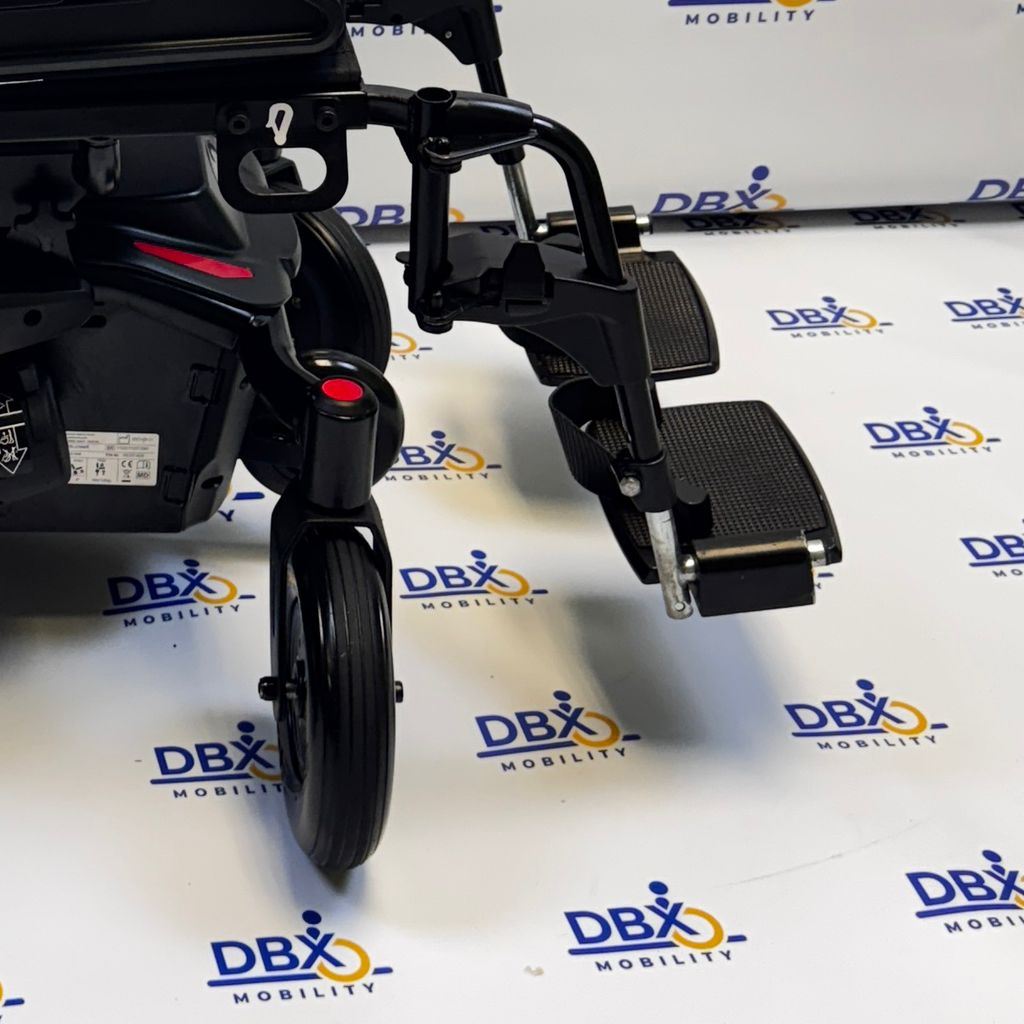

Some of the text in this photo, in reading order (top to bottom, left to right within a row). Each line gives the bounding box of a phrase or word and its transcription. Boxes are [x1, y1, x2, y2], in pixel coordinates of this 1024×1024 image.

[686, 10, 813, 24] MOBILITY
[651, 189, 771, 213] DBX
[766, 307, 859, 325] DBX
[864, 419, 964, 443] DBX
[400, 444, 465, 465] BX
[893, 447, 990, 457] MOBILITY
[385, 472, 489, 481] MOBILITY
[959, 535, 1024, 559] DB
[107, 572, 216, 606] DBX
[400, 566, 509, 591] DBX
[422, 598, 534, 609] MOBILITY
[123, 604, 240, 627] MOBILITY
[784, 697, 904, 730] DBX
[476, 707, 598, 747] DBX
[817, 736, 935, 749] MOBILITY
[154, 740, 274, 775] DBX
[502, 748, 625, 771] MOBILITY
[173, 784, 283, 798] MOBILIT
[905, 869, 1024, 906] DBX
[564, 903, 699, 944] DBX
[211, 933, 345, 975] DBX
[596, 950, 730, 971] MOBILITY
[234, 983, 373, 1003] MOBILITY
